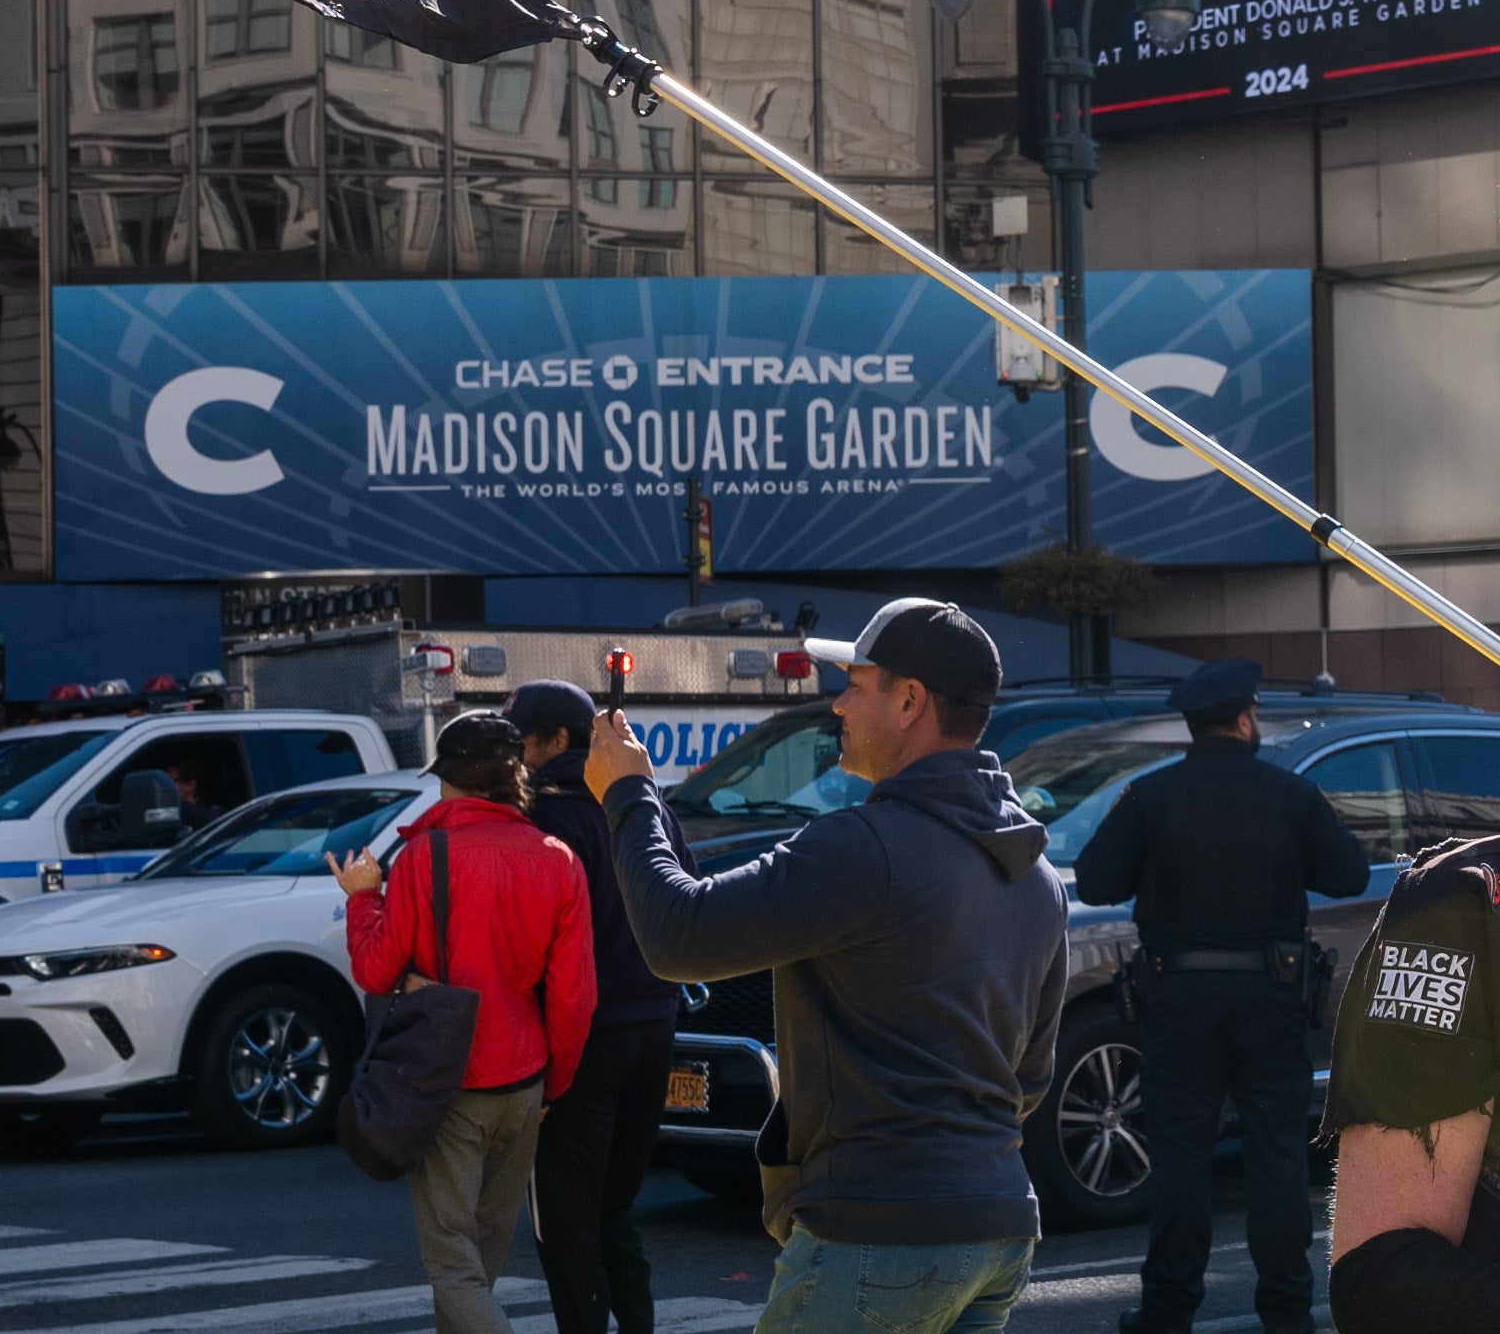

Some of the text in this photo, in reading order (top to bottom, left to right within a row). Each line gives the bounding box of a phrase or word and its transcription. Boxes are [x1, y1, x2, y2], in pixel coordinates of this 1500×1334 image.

[1096, 45, 1124, 67] AT
[1261, 9, 1361, 41] SQUARE
[1244, 64, 1310, 99] 2024
[454, 354, 914, 390] CHASE ENTRANCE
[460, 478, 898, 499] THE WORLD'S FAMOUS ARENA
[1382, 945, 1469, 978] BLACK
[1375, 971, 1463, 1007] LIVES
[1368, 999, 1456, 1030] MATTER
